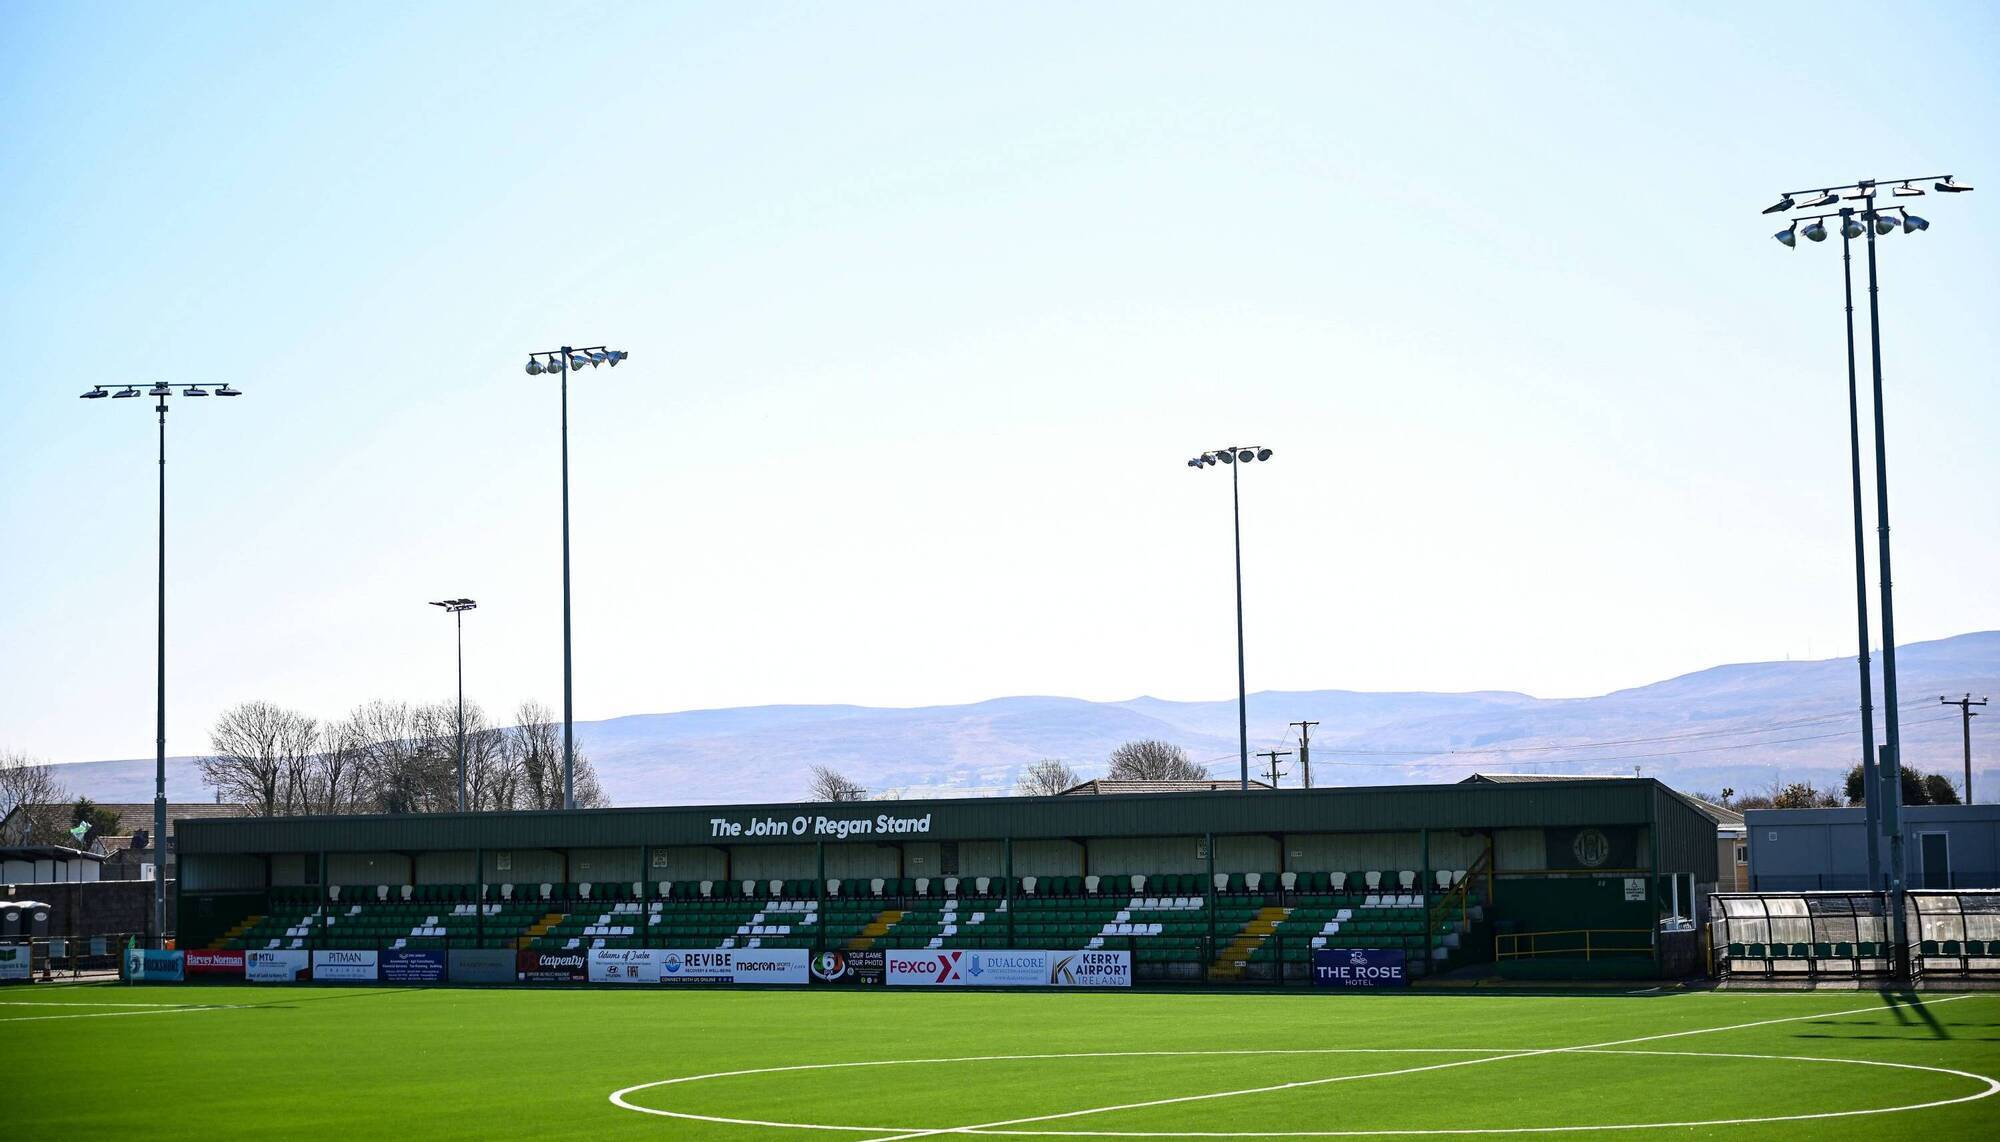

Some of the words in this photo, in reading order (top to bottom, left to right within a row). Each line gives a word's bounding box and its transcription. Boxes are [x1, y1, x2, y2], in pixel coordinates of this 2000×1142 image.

[710, 818, 741, 836] The
[744, 817, 788, 836] John
[792, 816, 812, 835] O'
[814, 816, 872, 839] Regan
[875, 814, 931, 834] Stand
[187, 954, 212, 966] Harvey
[213, 954, 243, 966] Norman
[258, 953, 274, 961] MTU
[328, 952, 362, 962] PITMAN
[539, 954, 585, 969] Carpentry
[598, 951, 620, 960] Adams
[621, 951, 631, 961] of
[685, 953, 732, 967] REVIBE
[822, 952, 835, 970] 6
[1082, 953, 1120, 964] KERRY
[736, 961, 776, 971] macron
[890, 959, 937, 974] Fexco
[987, 957, 1044, 968] DUALCORE
[627, 965, 639, 978] FIAT
[1075, 965, 1128, 976] AIRPORT
[1317, 966, 1350, 978] THE
[1355, 966, 1402, 978] ROSE
[1078, 976, 1125, 985] IRELAND
